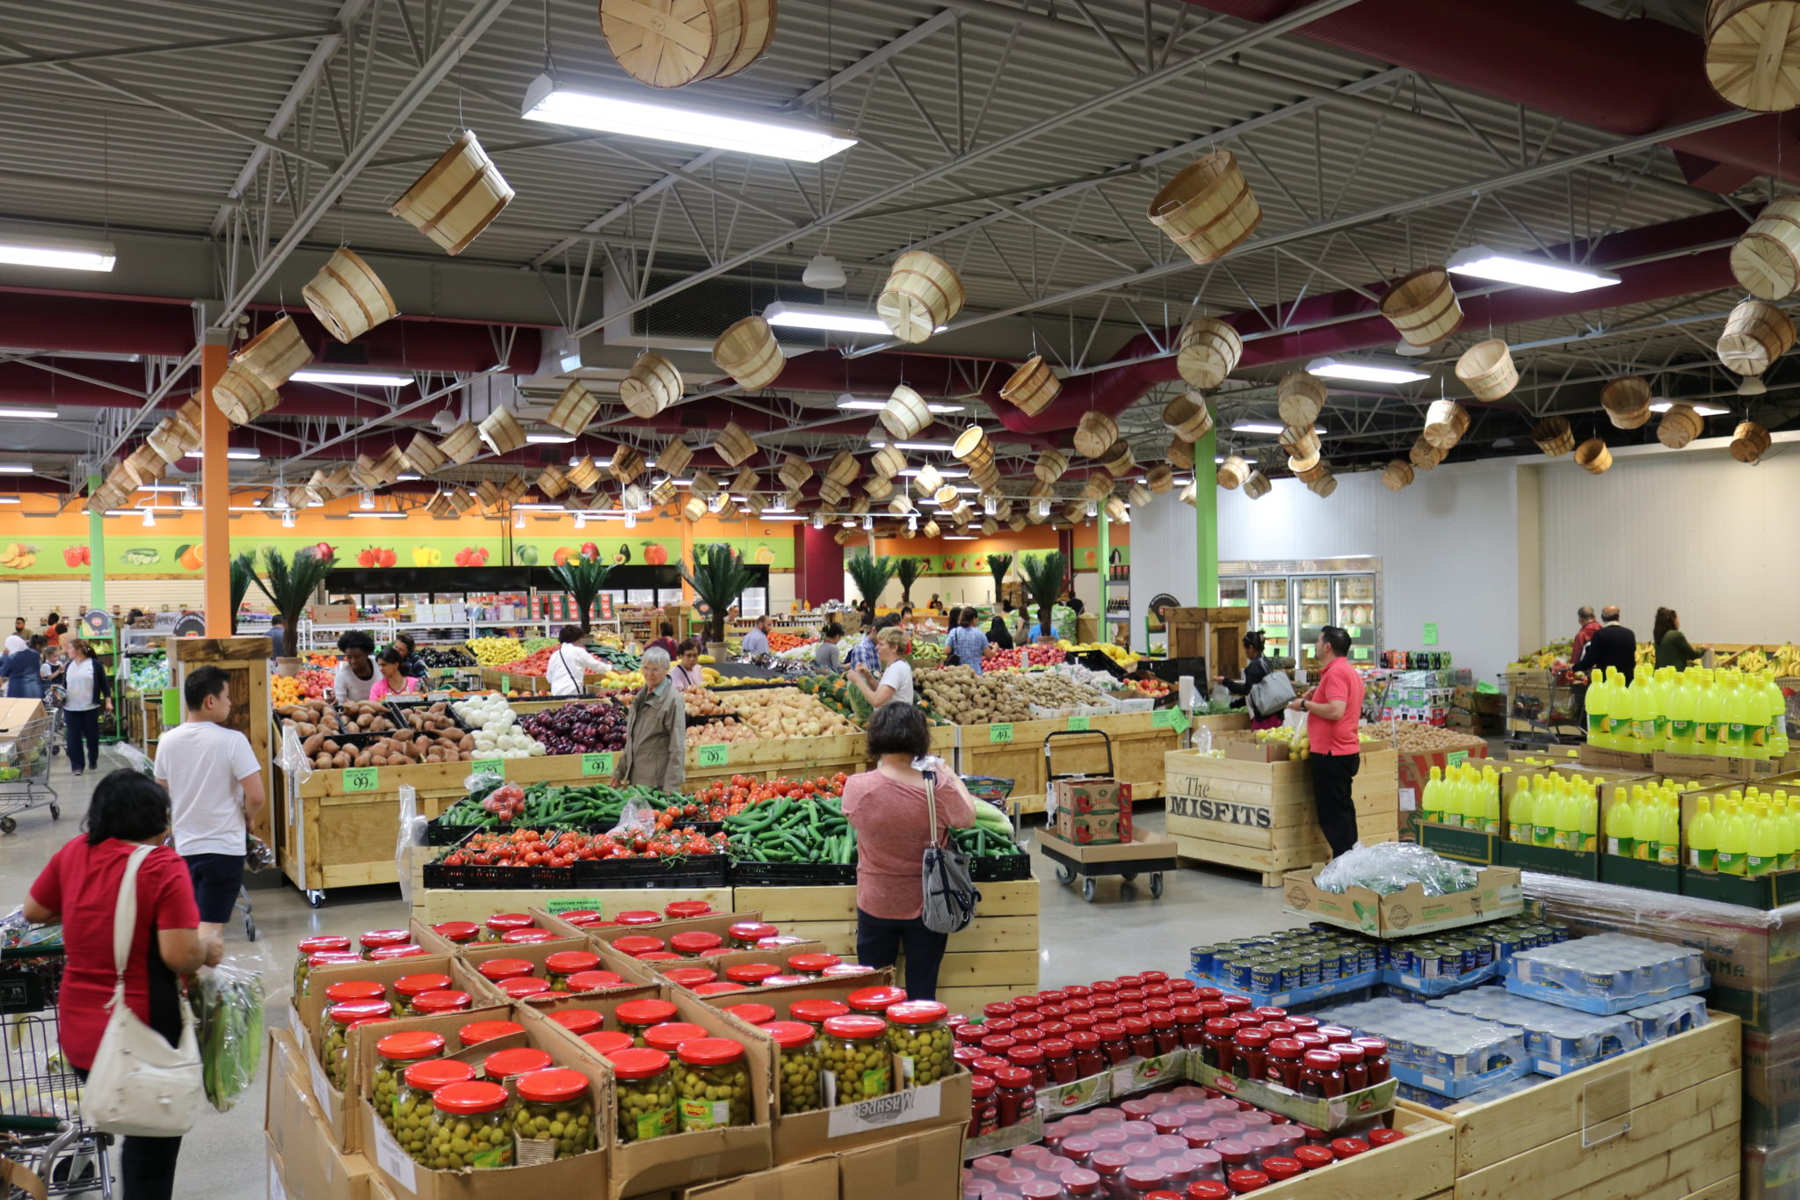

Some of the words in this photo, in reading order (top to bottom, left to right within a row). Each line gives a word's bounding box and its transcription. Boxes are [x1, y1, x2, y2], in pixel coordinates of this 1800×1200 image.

[353, 776, 369, 789] 99
[1185, 775, 1210, 798] The
[1170, 796, 1272, 829] MISFITS
